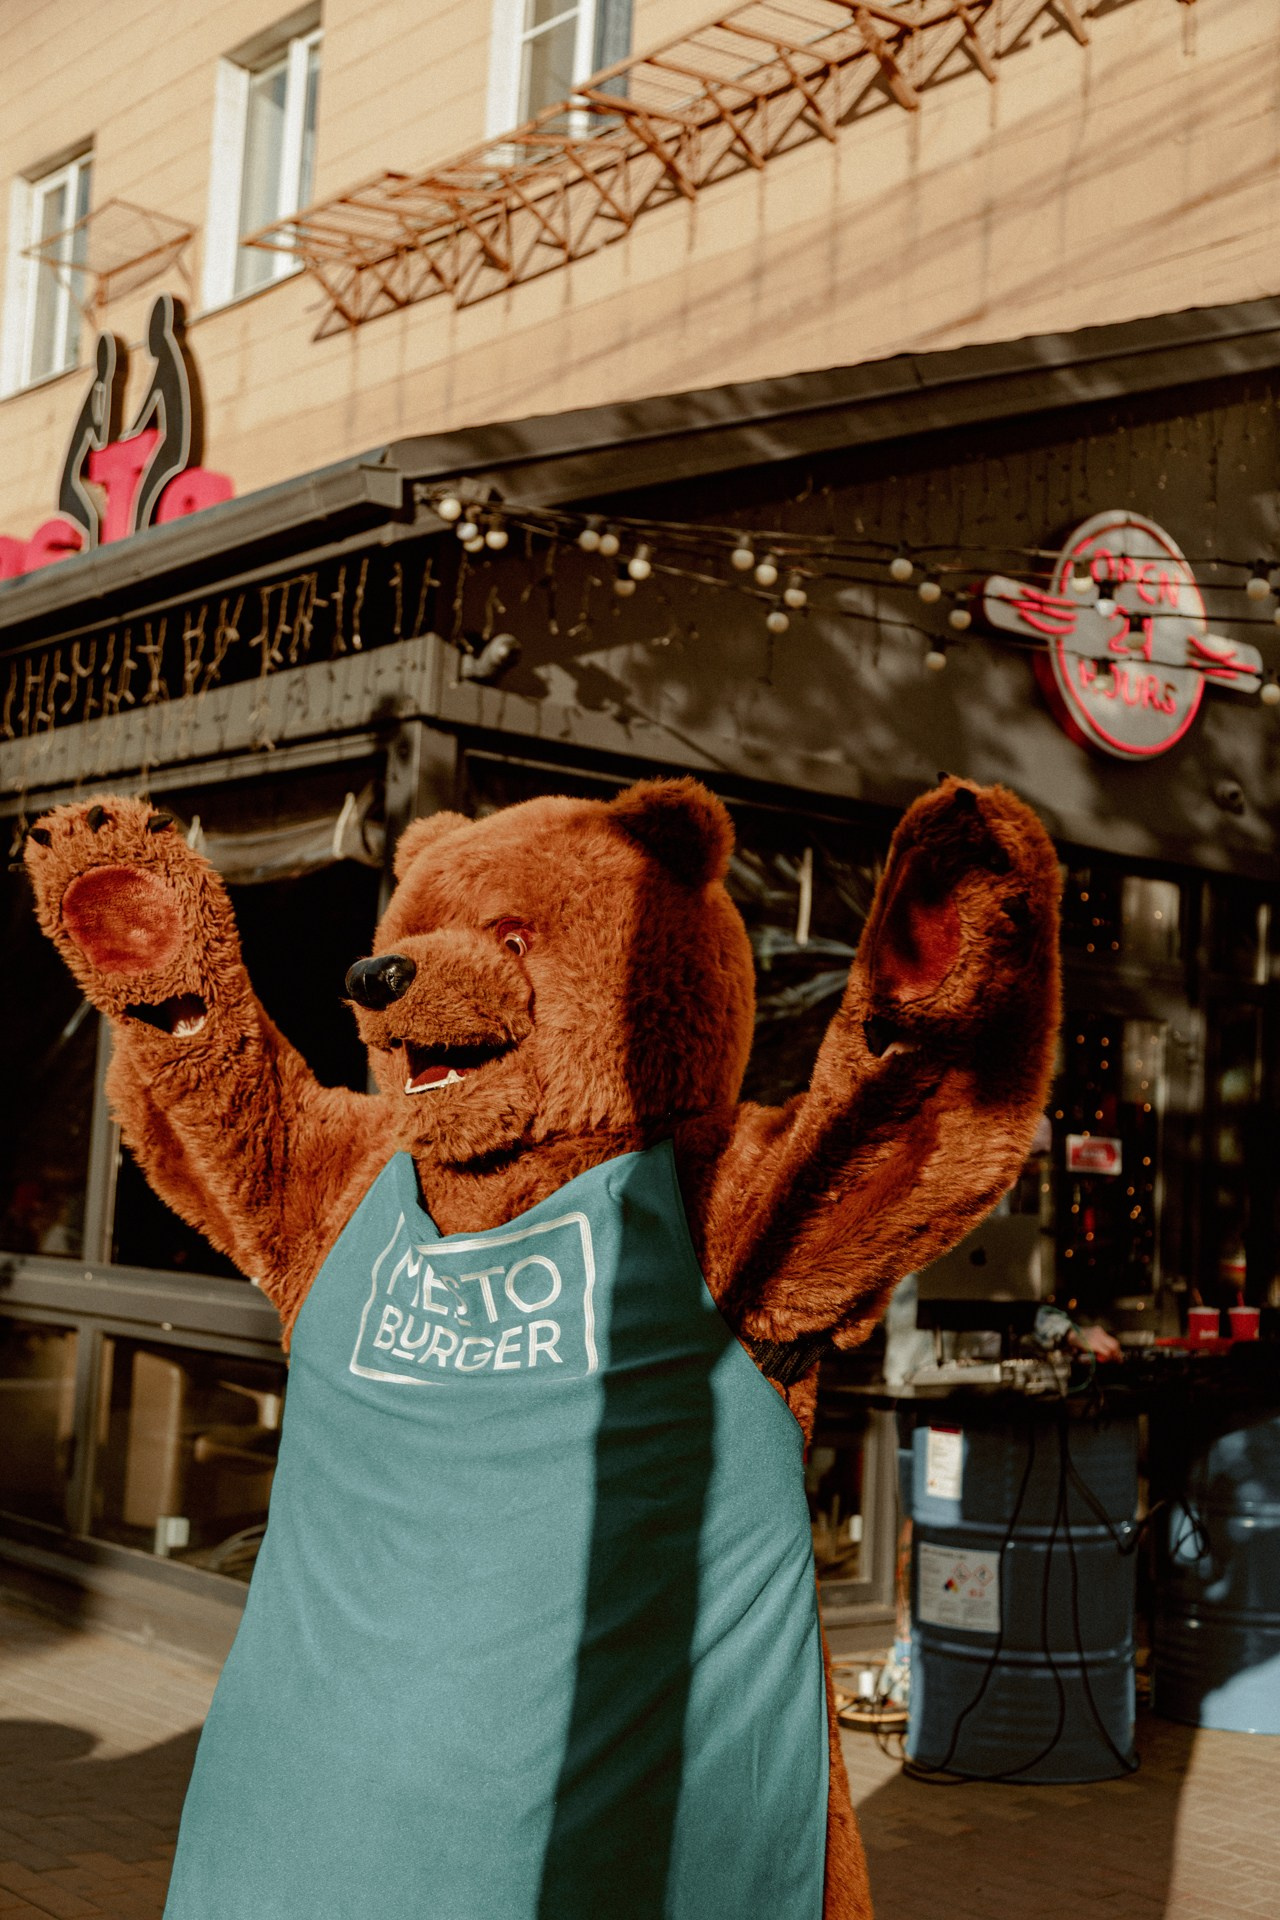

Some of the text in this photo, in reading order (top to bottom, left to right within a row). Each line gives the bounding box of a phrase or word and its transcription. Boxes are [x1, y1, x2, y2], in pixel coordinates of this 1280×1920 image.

[1090, 548, 1180, 608] OPEN
[387, 1246, 562, 1326] MESTO
[373, 1305, 563, 1371] BURGER
